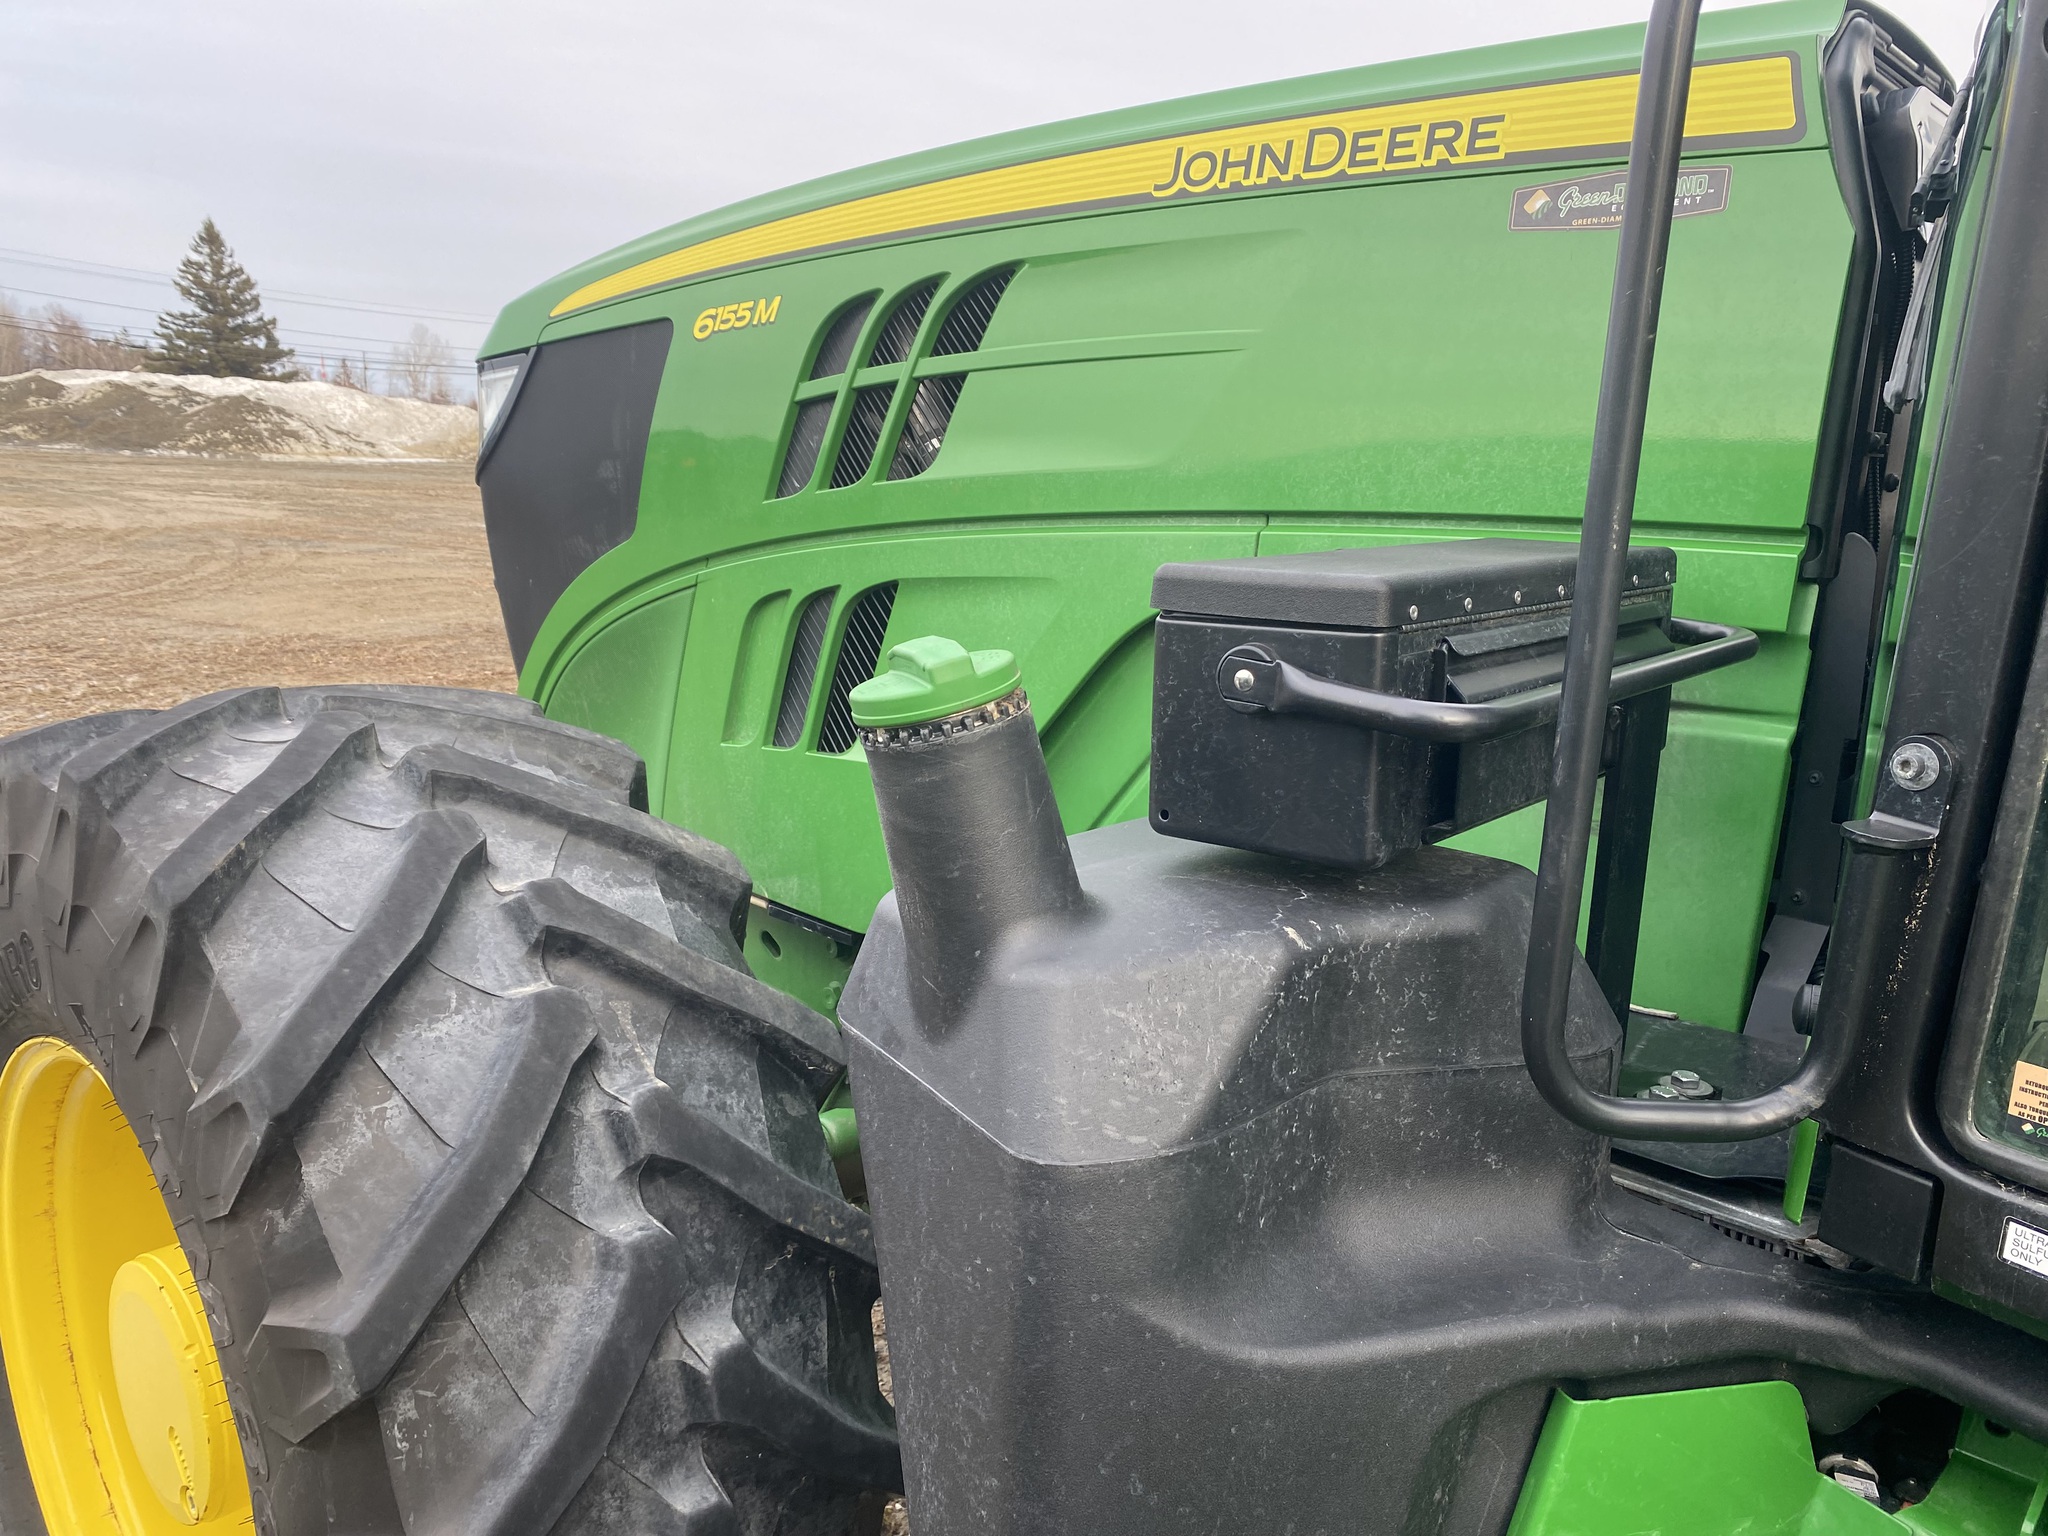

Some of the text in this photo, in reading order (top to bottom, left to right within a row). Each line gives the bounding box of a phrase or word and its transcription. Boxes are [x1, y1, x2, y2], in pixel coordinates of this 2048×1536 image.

[1153, 114, 1506, 193] JOHN DEERE
[1572, 215, 1623, 226] GREEN-DIAM
[2010, 1248, 2043, 1266] ONLY
[2012, 1238, 2048, 1259] SULFU
